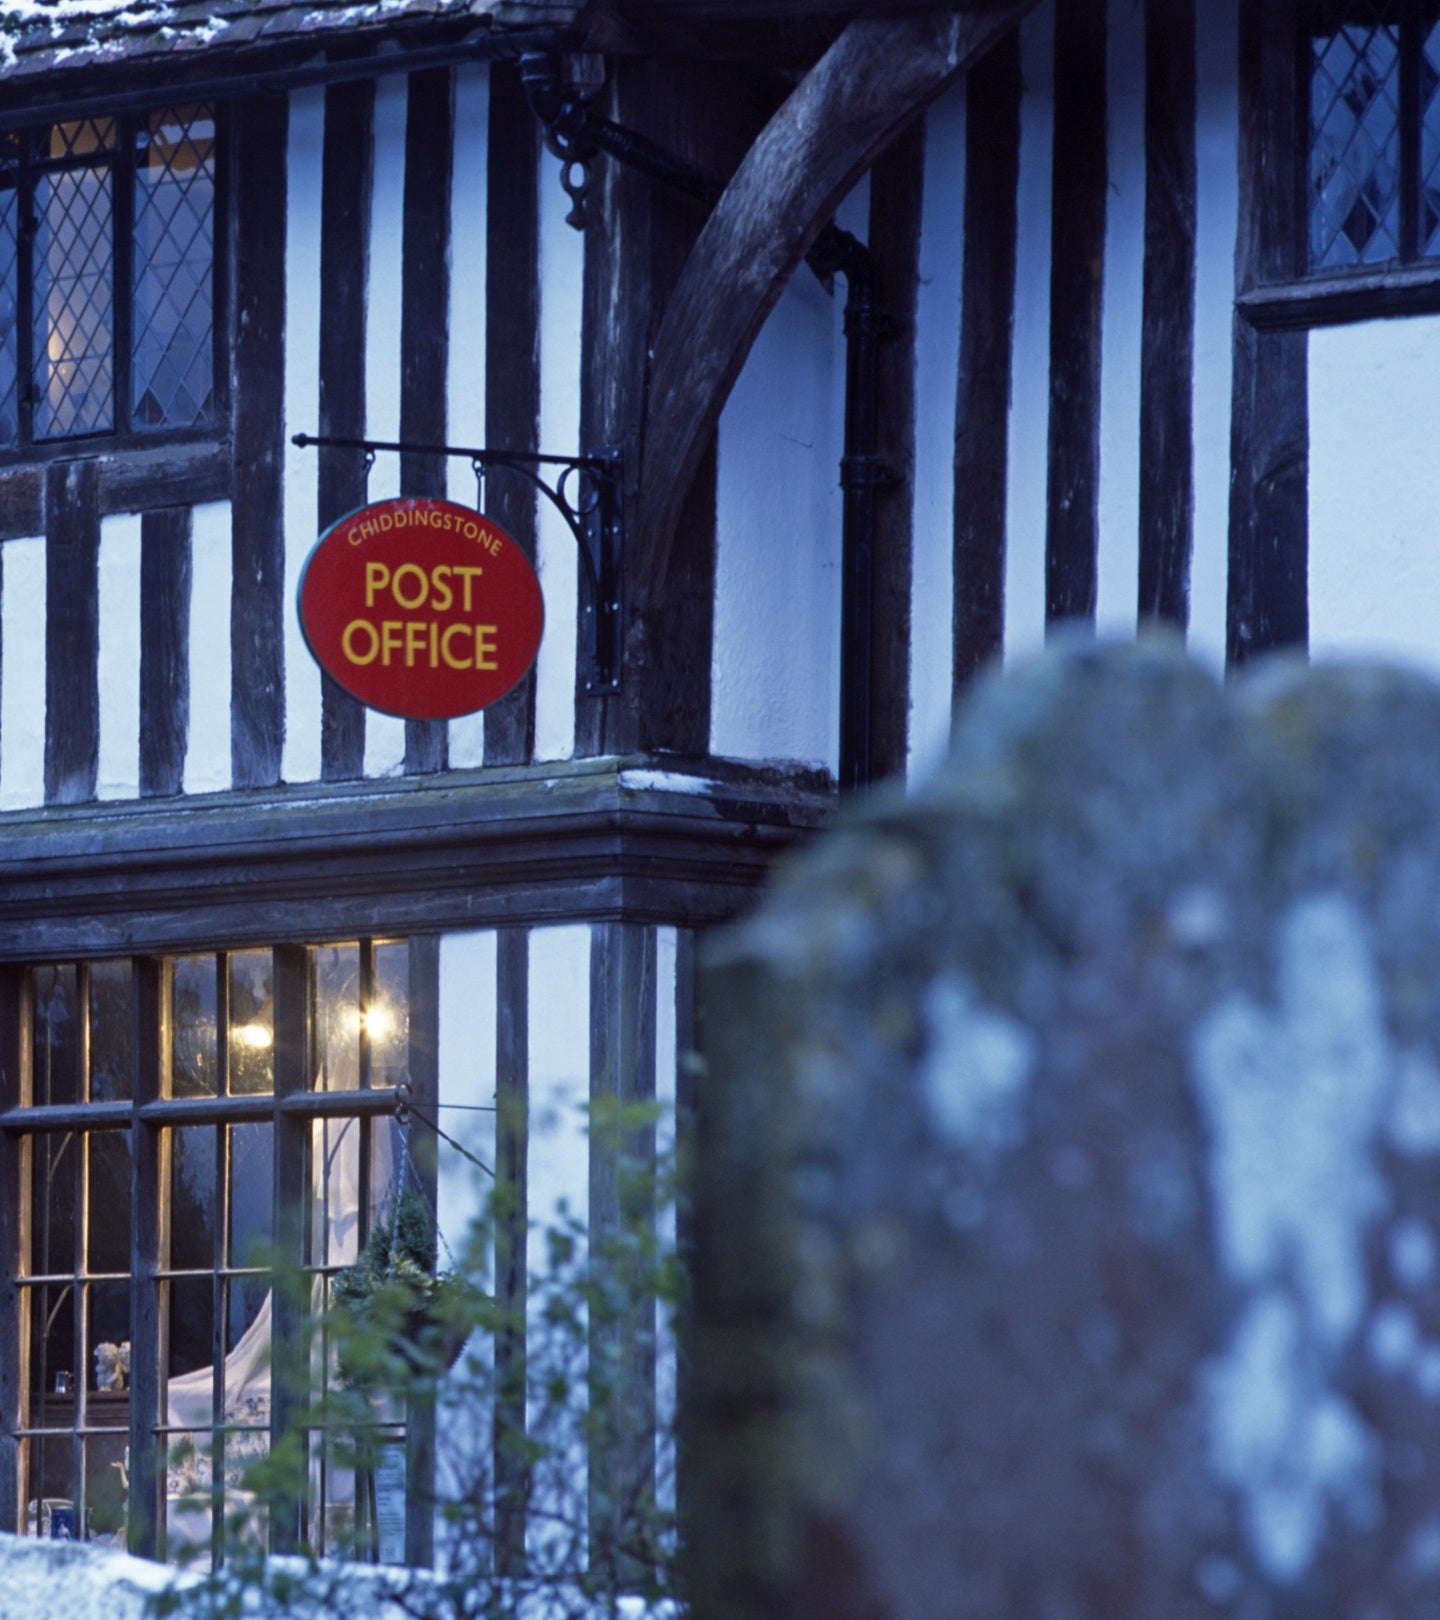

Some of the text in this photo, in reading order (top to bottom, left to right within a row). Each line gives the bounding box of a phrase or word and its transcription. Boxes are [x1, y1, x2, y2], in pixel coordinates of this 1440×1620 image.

[348, 510, 502, 556] CHIDDINGSTONE
[365, 562, 482, 611] POST
[342, 619, 498, 670] OFFICE
